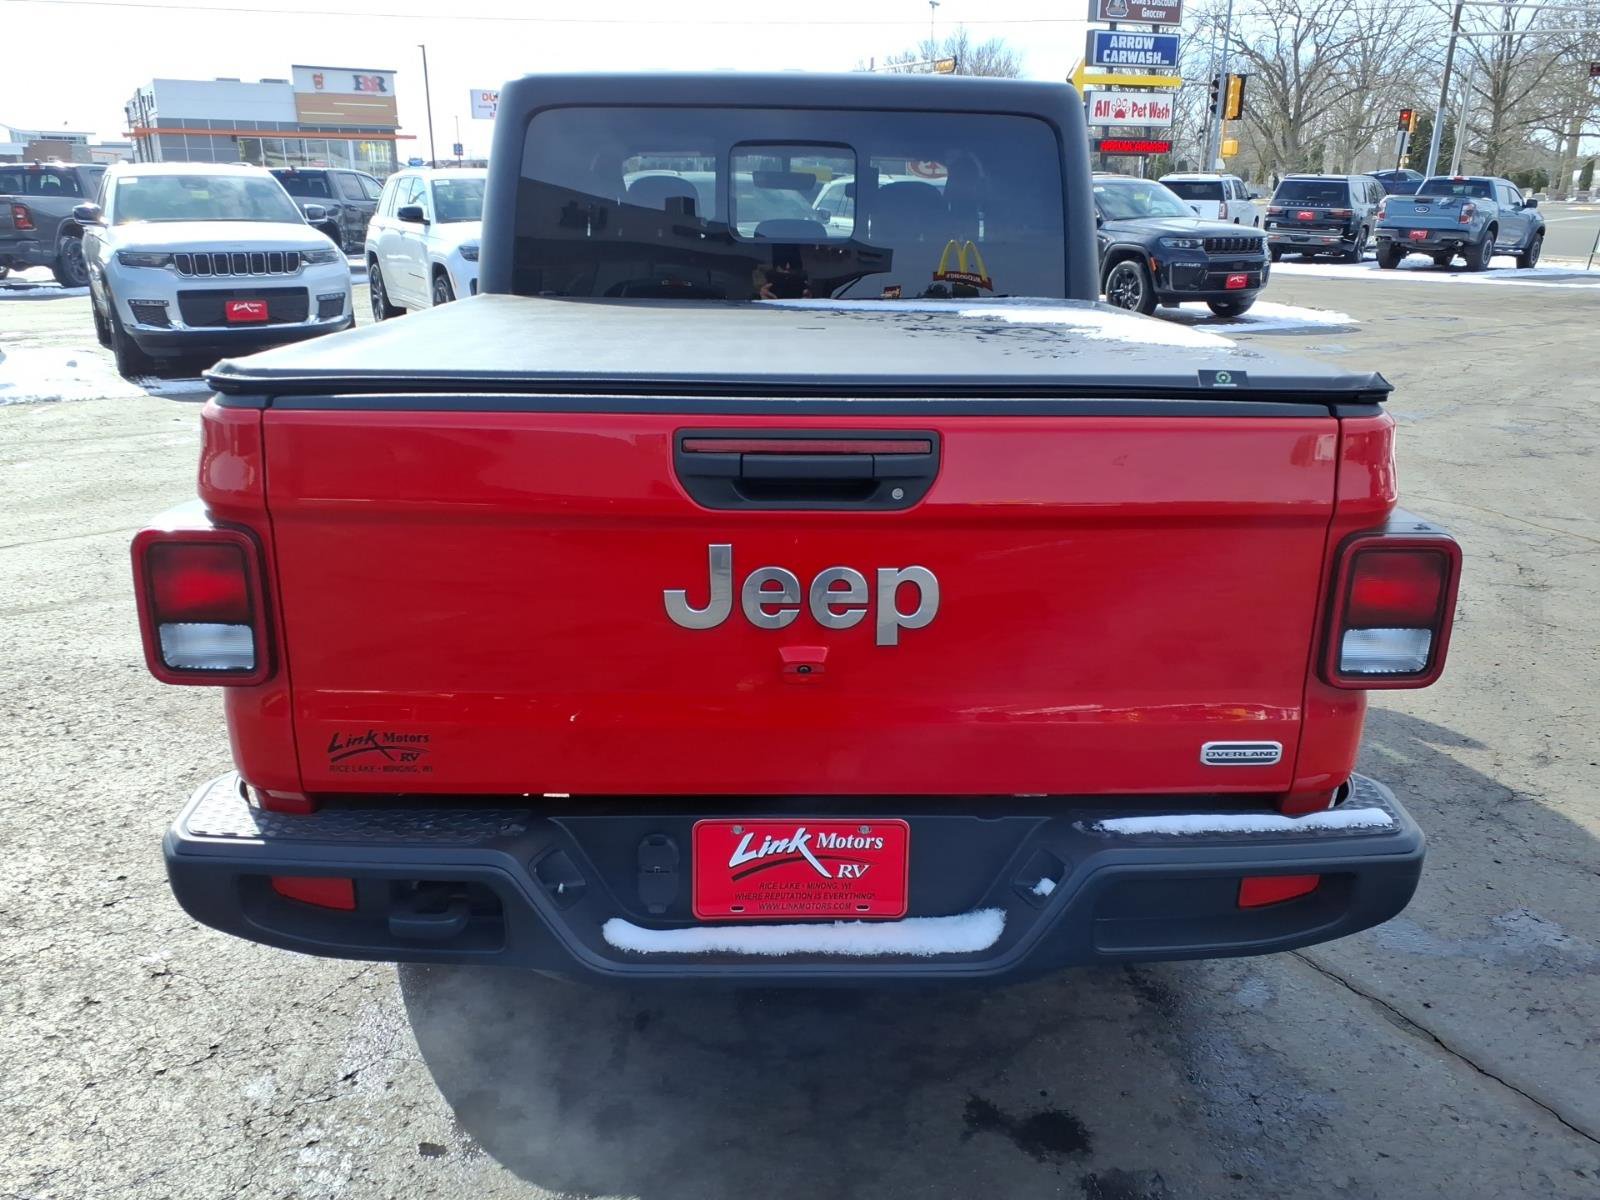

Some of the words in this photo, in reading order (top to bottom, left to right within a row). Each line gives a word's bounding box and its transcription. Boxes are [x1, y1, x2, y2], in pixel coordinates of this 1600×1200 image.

[1141, 7, 1167, 18] GROCERY
[1110, 35, 1154, 50] ARROW
[1094, 99, 1111, 118] All
[1131, 101, 1147, 119] Pet
[1149, 102, 1171, 120] Wash
[663, 543, 940, 646] Jeep
[327, 729, 396, 762] Link
[382, 732, 430, 744] Motors
[400, 752, 420, 762] RV
[1206, 750, 1279, 758] OVERLAND
[728, 827, 832, 879] Link
[816, 832, 884, 850] Motors
[837, 864, 871, 879] RV
[759, 882, 779, 890] RICE
[780, 882, 801, 890] LAKE
[764, 891, 813, 900] REPUTATION
[758, 902, 852, 910] WWW.LINKMOTORS.COM
